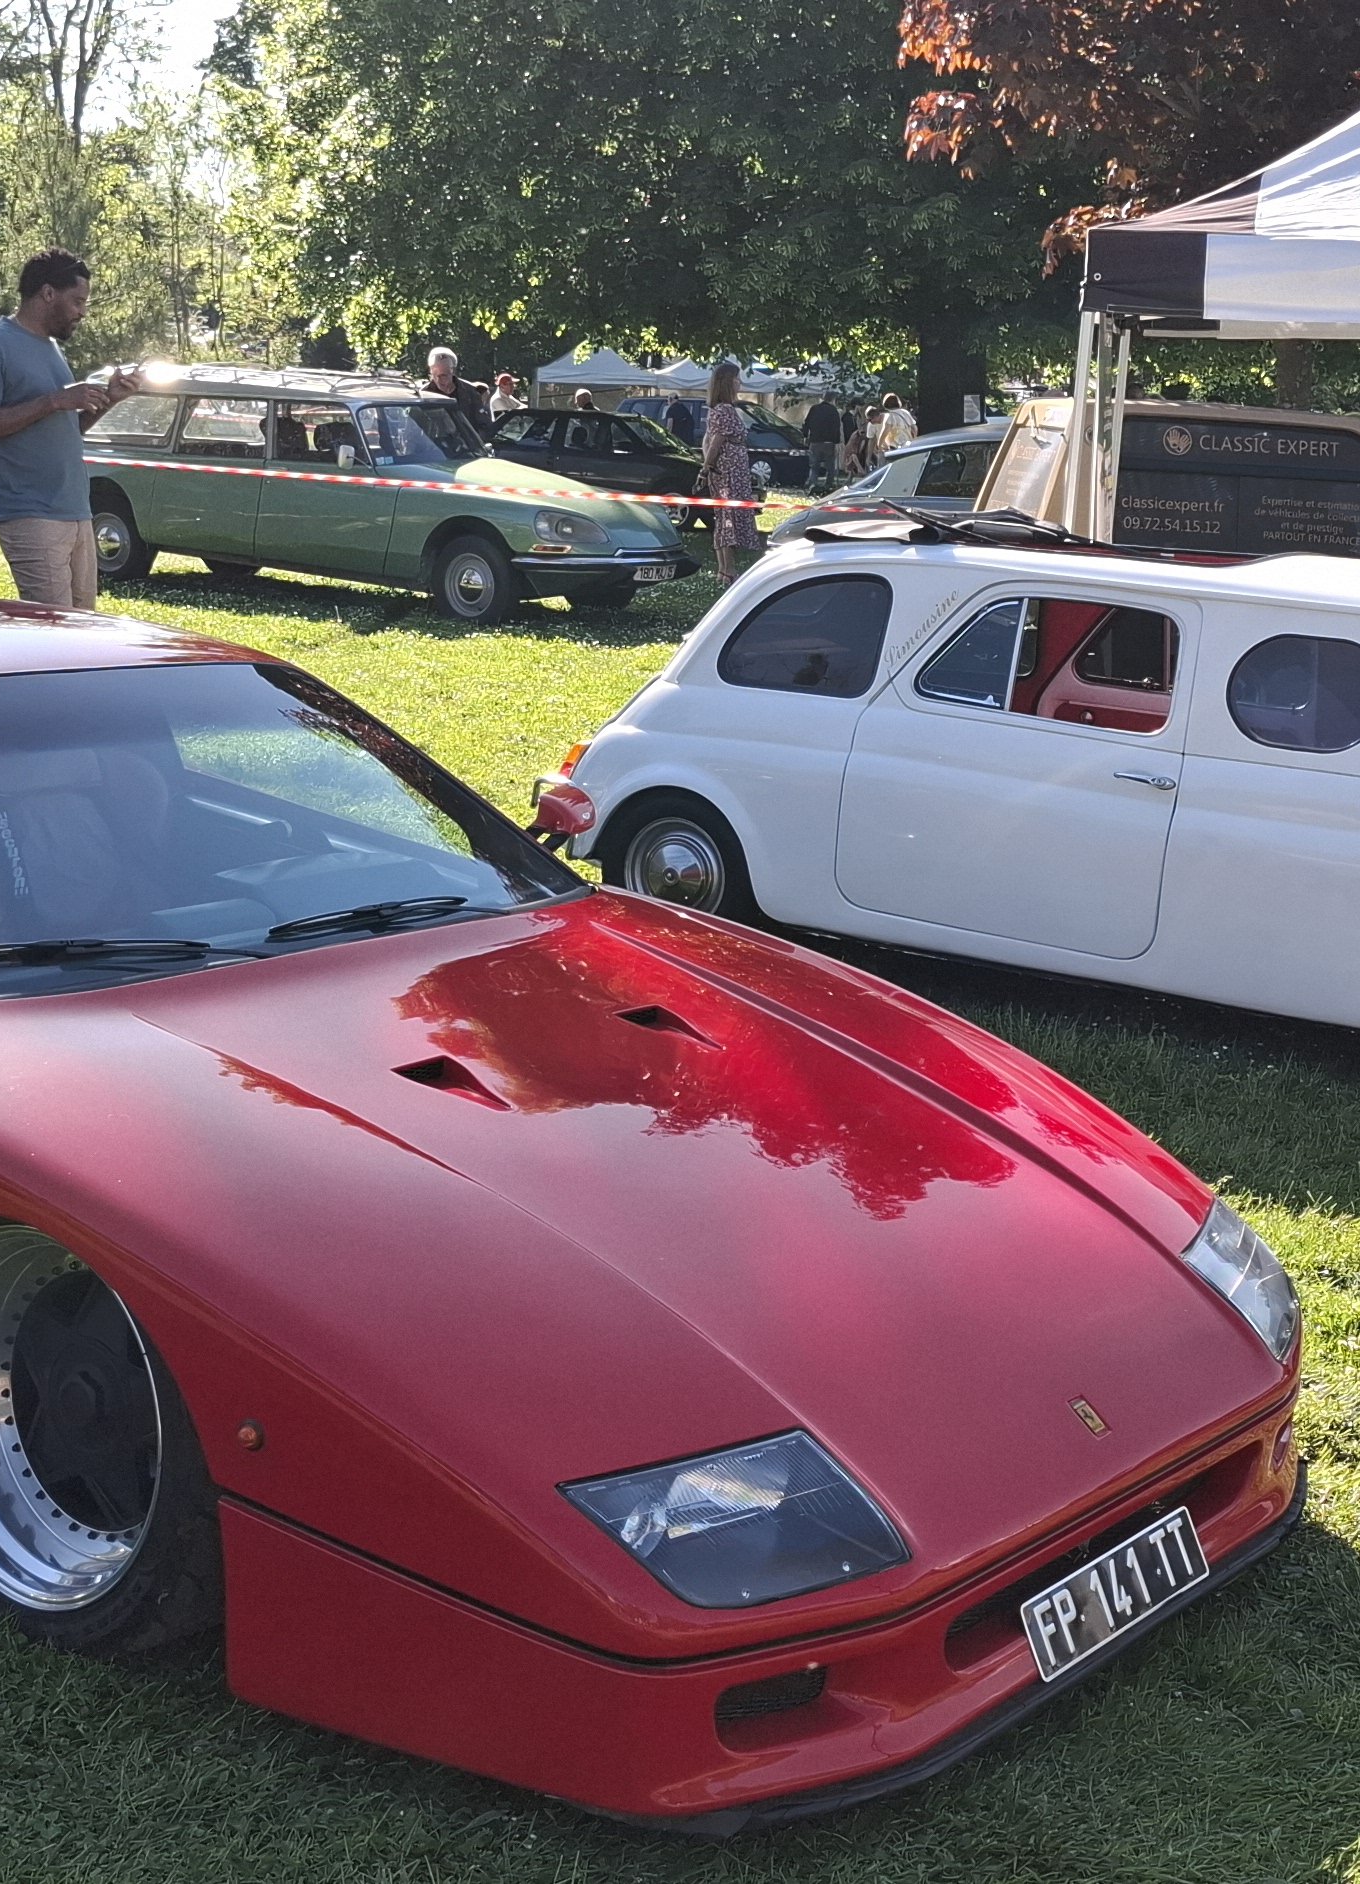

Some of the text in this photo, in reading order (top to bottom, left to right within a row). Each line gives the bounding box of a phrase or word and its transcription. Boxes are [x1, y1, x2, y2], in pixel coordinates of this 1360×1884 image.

[1200, 434, 1340, 457] CLASSIC EXPERT
[1121, 495, 1225, 514] classicexpert.fr
[1261, 495, 1304, 507] Expertise
[1306, 500, 1316, 508] et
[1254, 507, 1266, 516] de
[1269, 508, 1311, 519] véhicules
[1313, 511, 1325, 520] de
[1123, 516, 1221, 534] 09.72.54.15.12
[1280, 522, 1344, 535] et de prestige
[1263, 530, 1360, 546] PARTOUT EN FRANCE
[883, 589, 961, 667] Limousine
[1033, 1517, 1194, 1667] FP 141 TT
